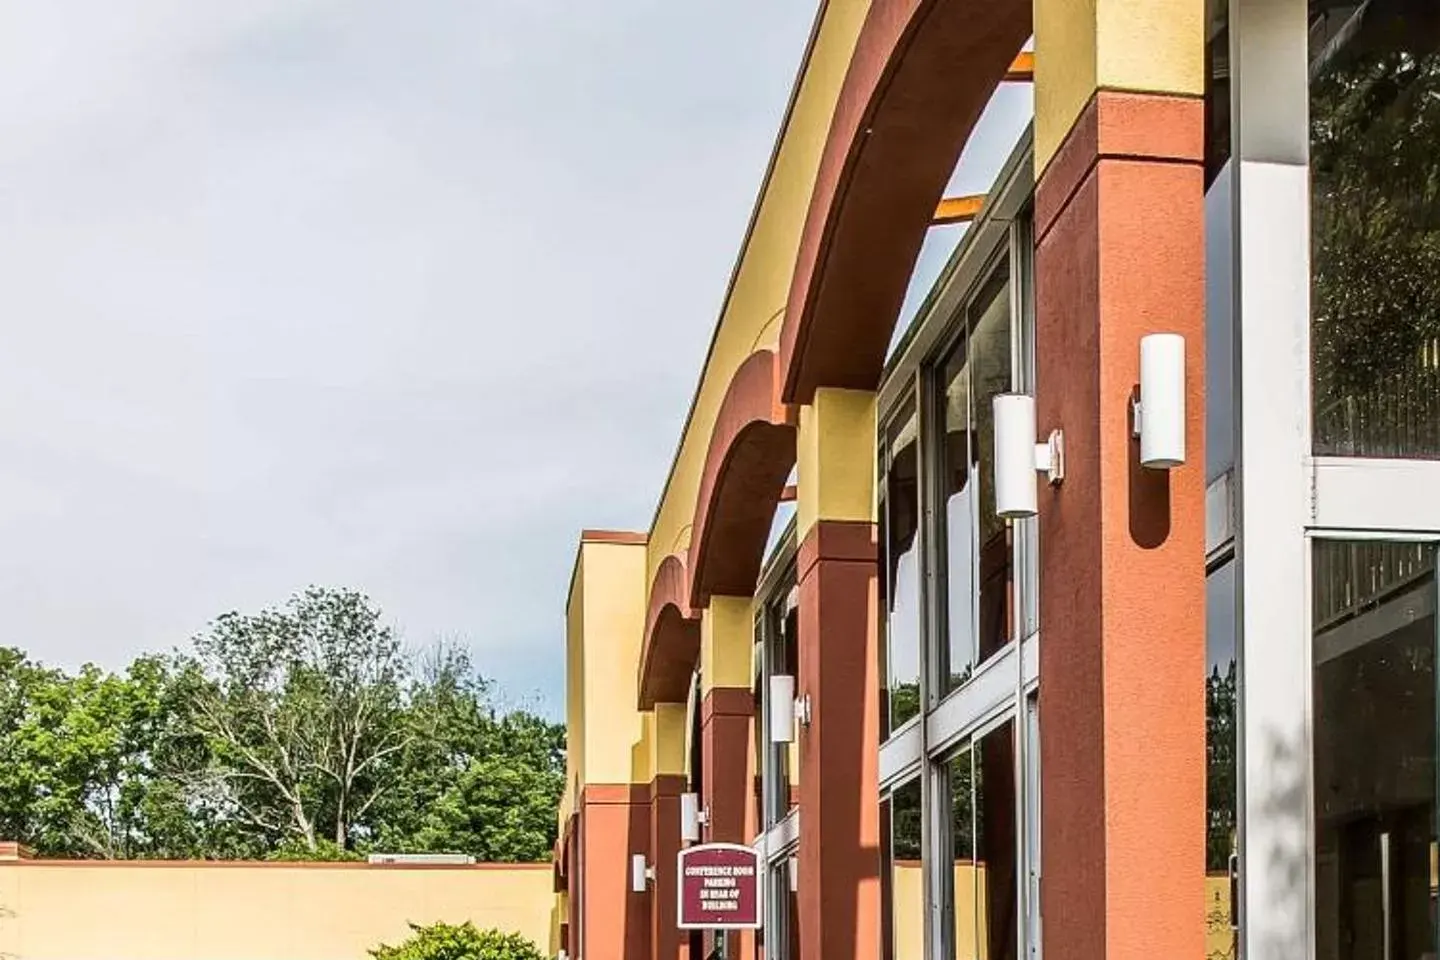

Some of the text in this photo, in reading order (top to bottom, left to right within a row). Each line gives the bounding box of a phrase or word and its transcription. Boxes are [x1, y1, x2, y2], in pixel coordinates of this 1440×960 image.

[685, 866, 732, 877] CONFERENCE
[704, 878, 736, 888] PARKING
[700, 889, 740, 899] IN REAR OF
[701, 900, 738, 911] BUILDING
